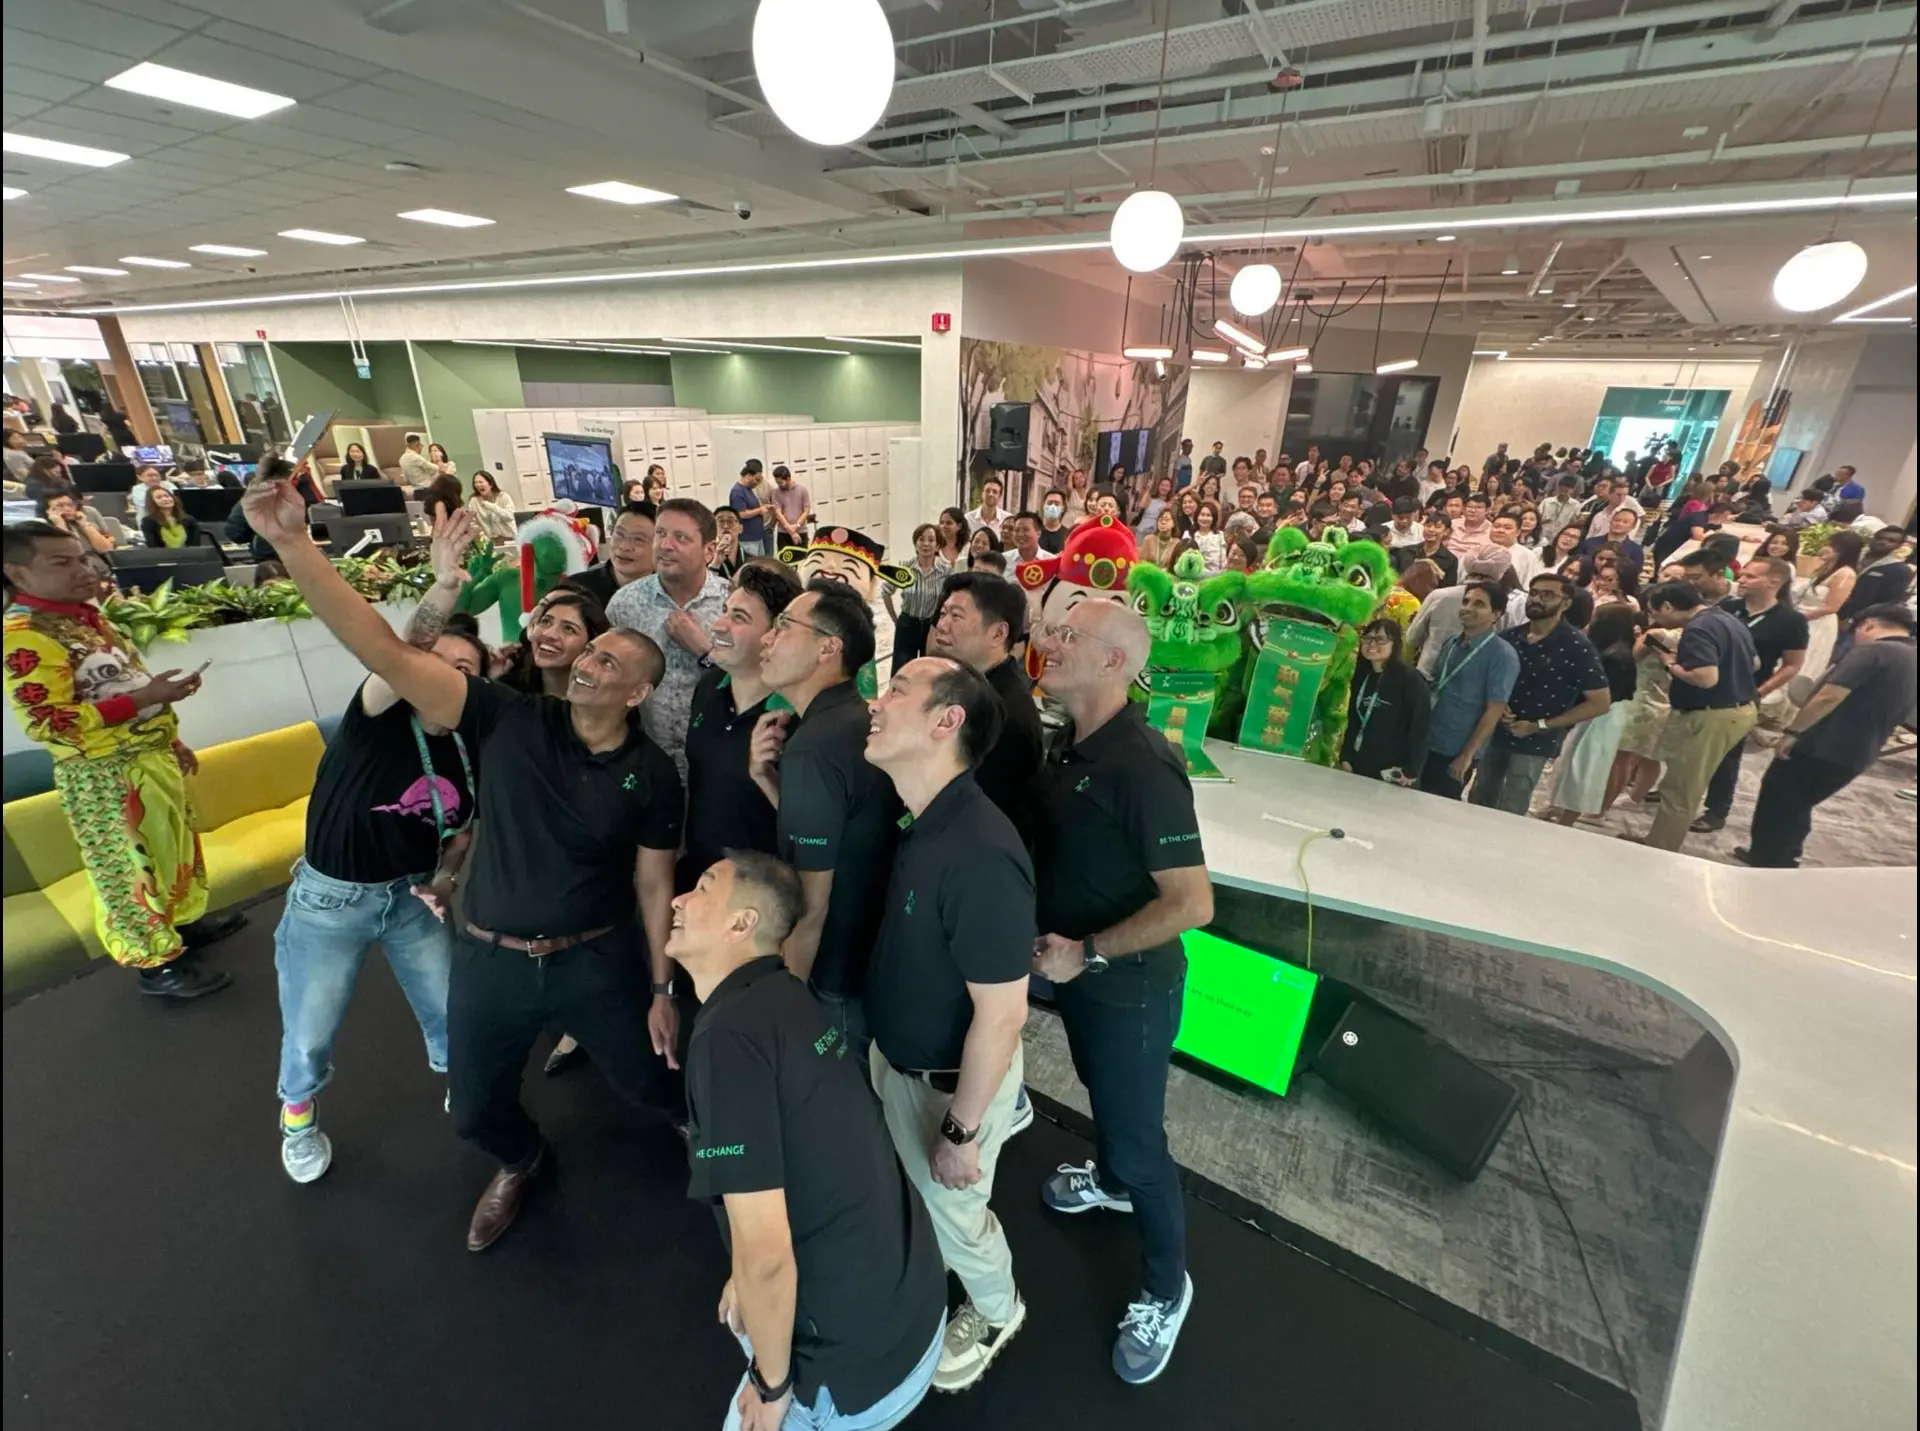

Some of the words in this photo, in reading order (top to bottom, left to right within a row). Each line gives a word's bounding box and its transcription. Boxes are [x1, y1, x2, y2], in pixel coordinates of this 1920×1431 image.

[799, 837, 828, 846] CHANGE
[1168, 835, 1181, 843] THE
[696, 1149, 706, 1159] HE
[706, 1144, 745, 1158] CHANGE
